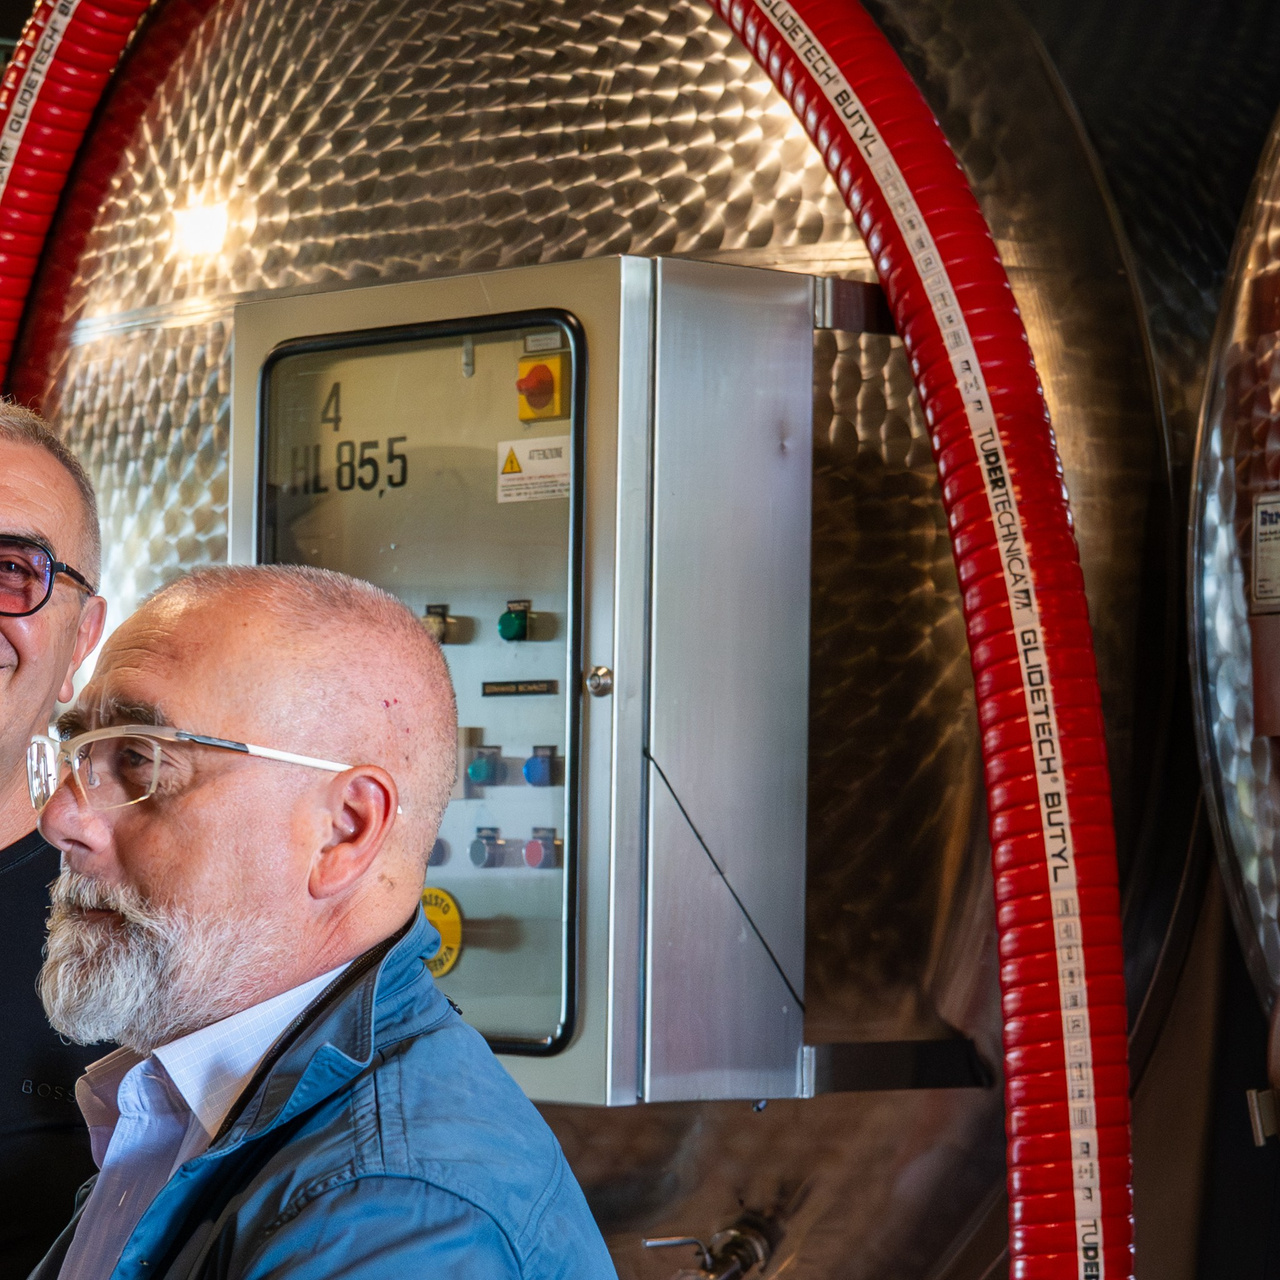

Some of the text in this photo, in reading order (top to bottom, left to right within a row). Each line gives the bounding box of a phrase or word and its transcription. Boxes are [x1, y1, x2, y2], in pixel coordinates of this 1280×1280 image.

[834, 90, 878, 158] BUTYL
[321, 382, 342, 432] 4
[336, 436, 408, 499] 85,5
[978, 428, 1025, 587] TUDERTECHNICA
[1044, 792, 1069, 883] BUTYL
